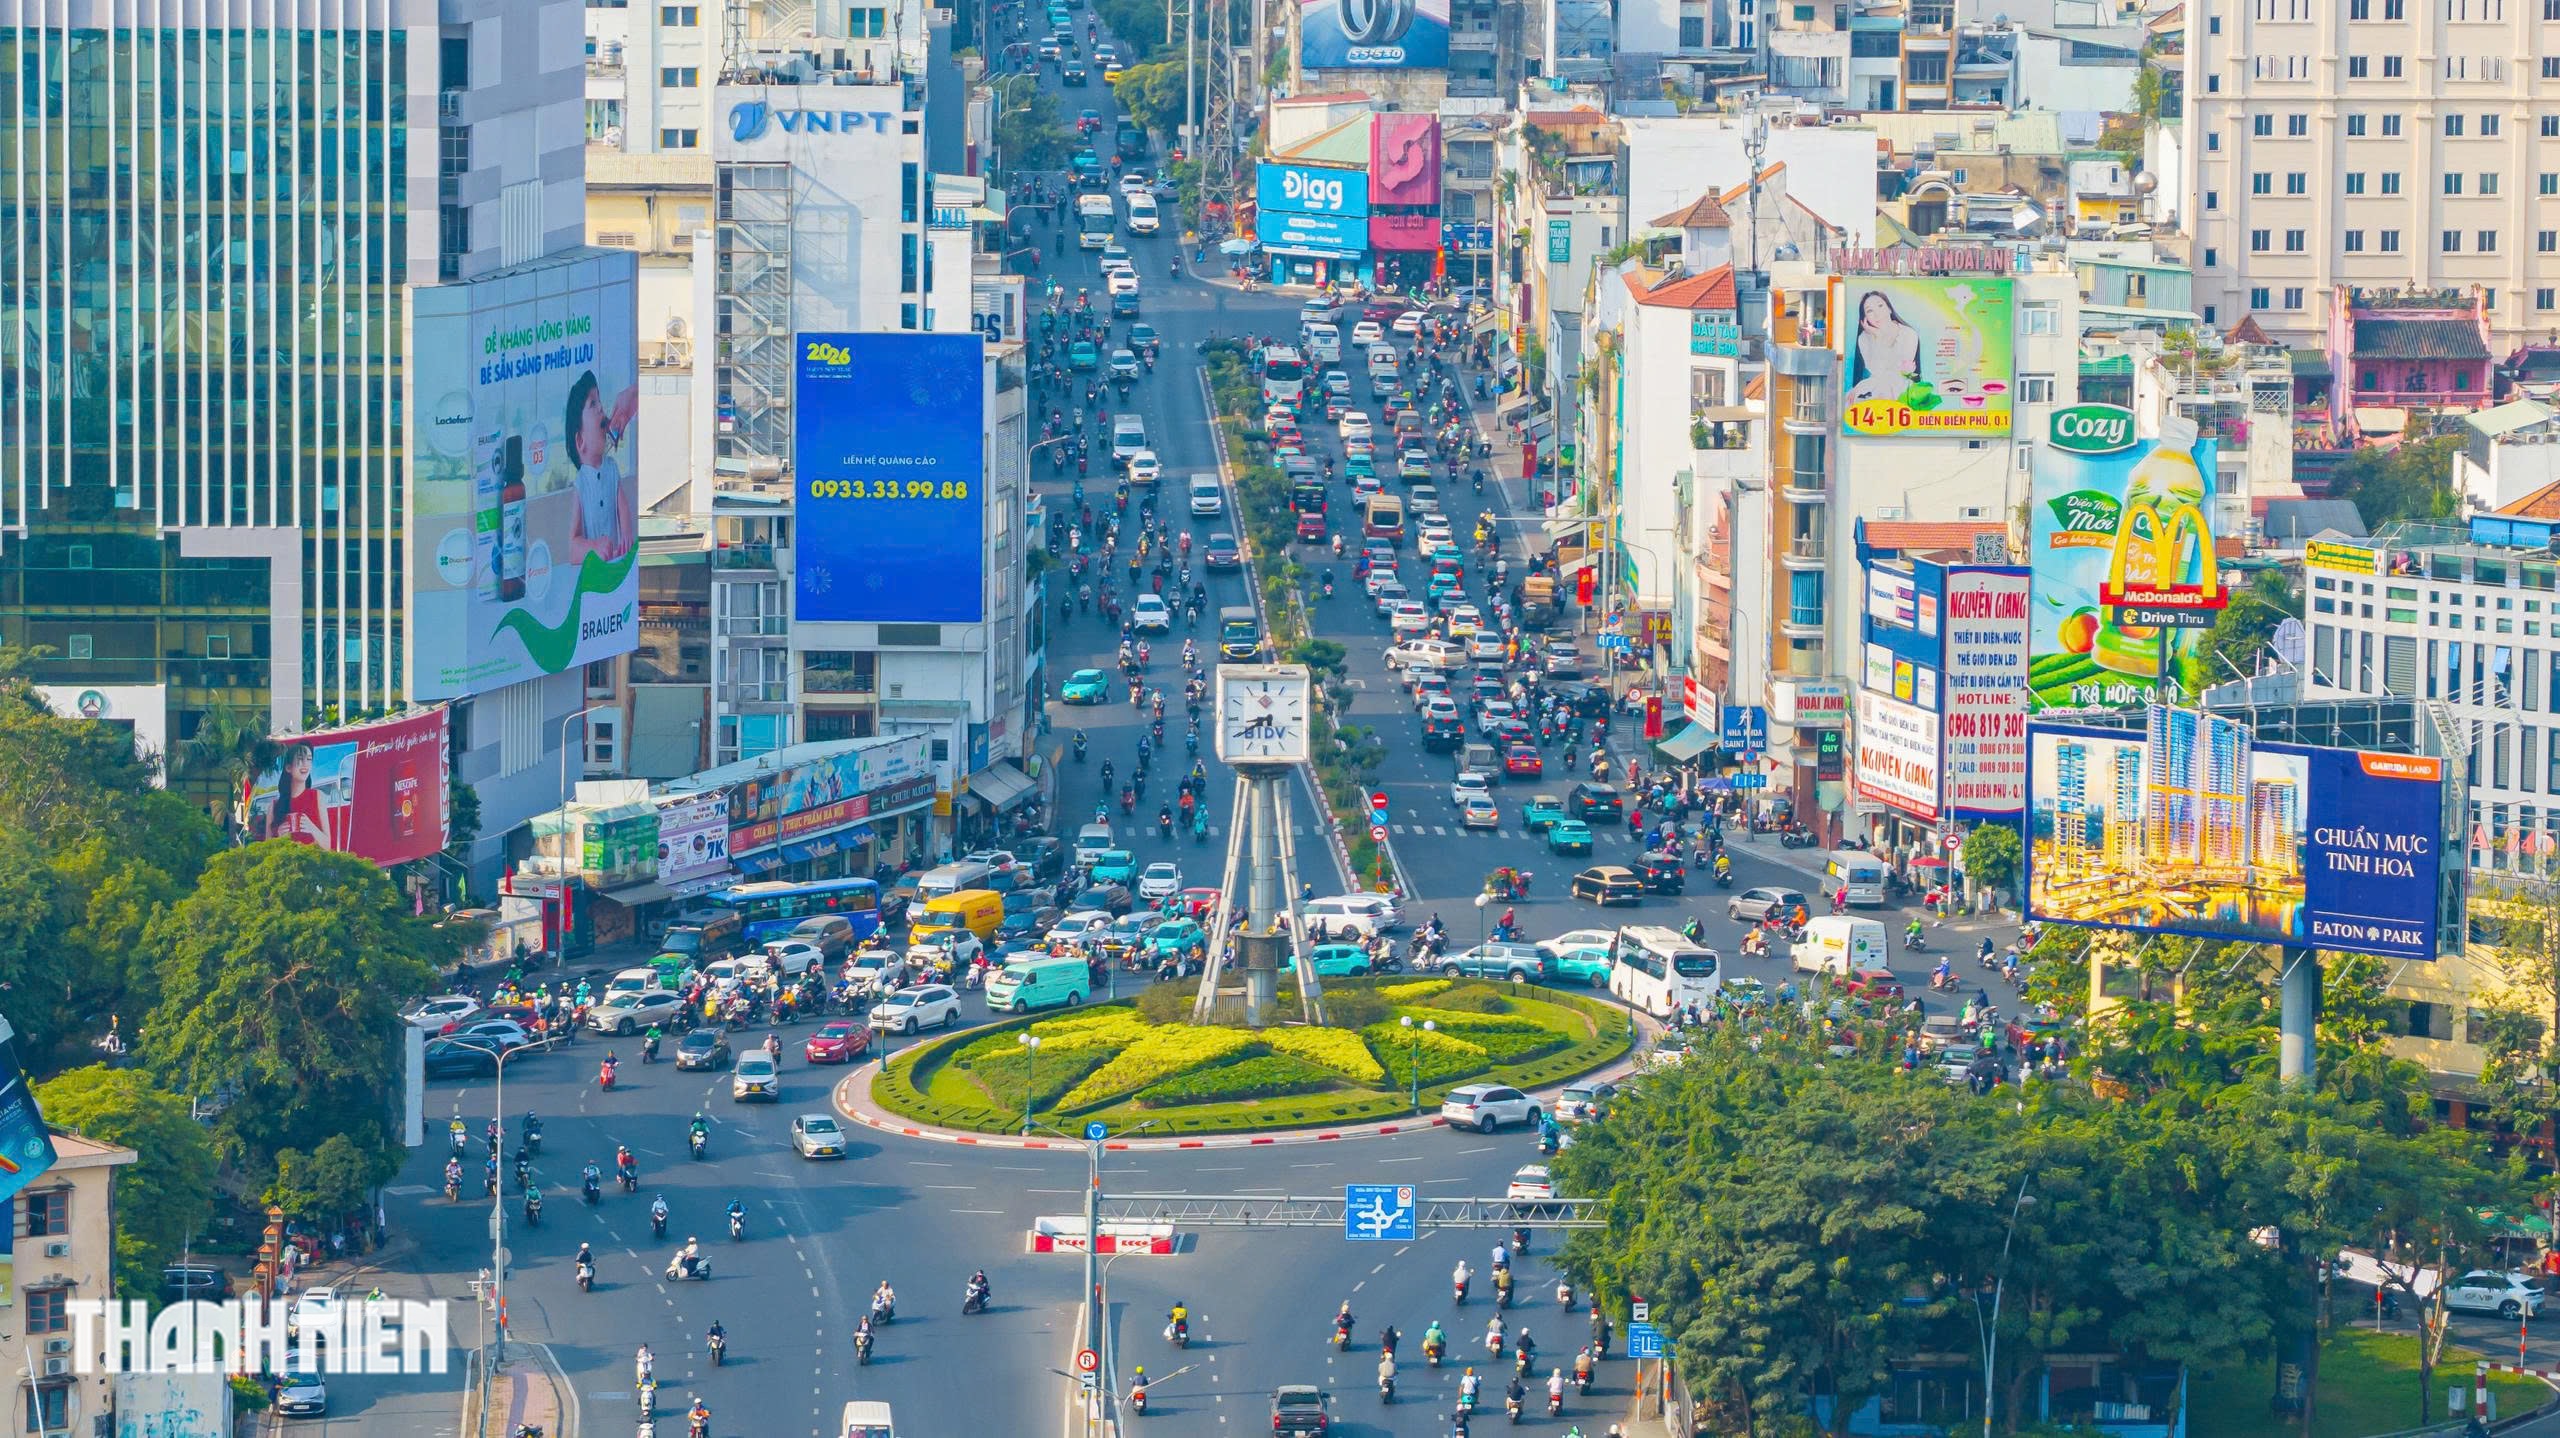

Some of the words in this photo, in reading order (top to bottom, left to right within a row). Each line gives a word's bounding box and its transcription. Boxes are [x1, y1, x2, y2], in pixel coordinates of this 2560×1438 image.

[775, 111, 893, 134] VNPT
[807, 343, 851, 365] 2026
[1850, 406, 1911, 427] 14-16
[2057, 413, 2126, 444] Cozy
[811, 480, 967, 499] 0933.33.99.88
[1950, 582, 1992, 619] NGUYỄN
[1995, 591, 2026, 619] GIANG
[2124, 591, 2203, 604] McDonald's
[582, 613, 623, 640] BRAUER
[2141, 611, 2175, 624] Drive
[2178, 612, 2204, 624] Thru
[2005, 654, 2018, 666] LED
[1824, 696, 1844, 710] ANH
[1957, 693, 2016, 705] HOTLINE:
[1244, 726, 1286, 739] BIDV
[1727, 729, 1742, 737] NHA
[1948, 713, 1976, 738] 0906
[1979, 713, 2000, 738] 819
[2004, 713, 2024, 738] 300
[1724, 740, 1744, 748] SAINT
[1905, 761, 1933, 790] GIANG
[2409, 764, 2432, 775] LAND
[2314, 826, 2379, 850] CHUẨN
[2384, 833, 2428, 856] MỰC
[2326, 851, 2369, 873] TINH
[2375, 858, 2415, 878] HOA
[2313, 920, 2364, 939] EATON
[2382, 928, 2424, 945] PARK
